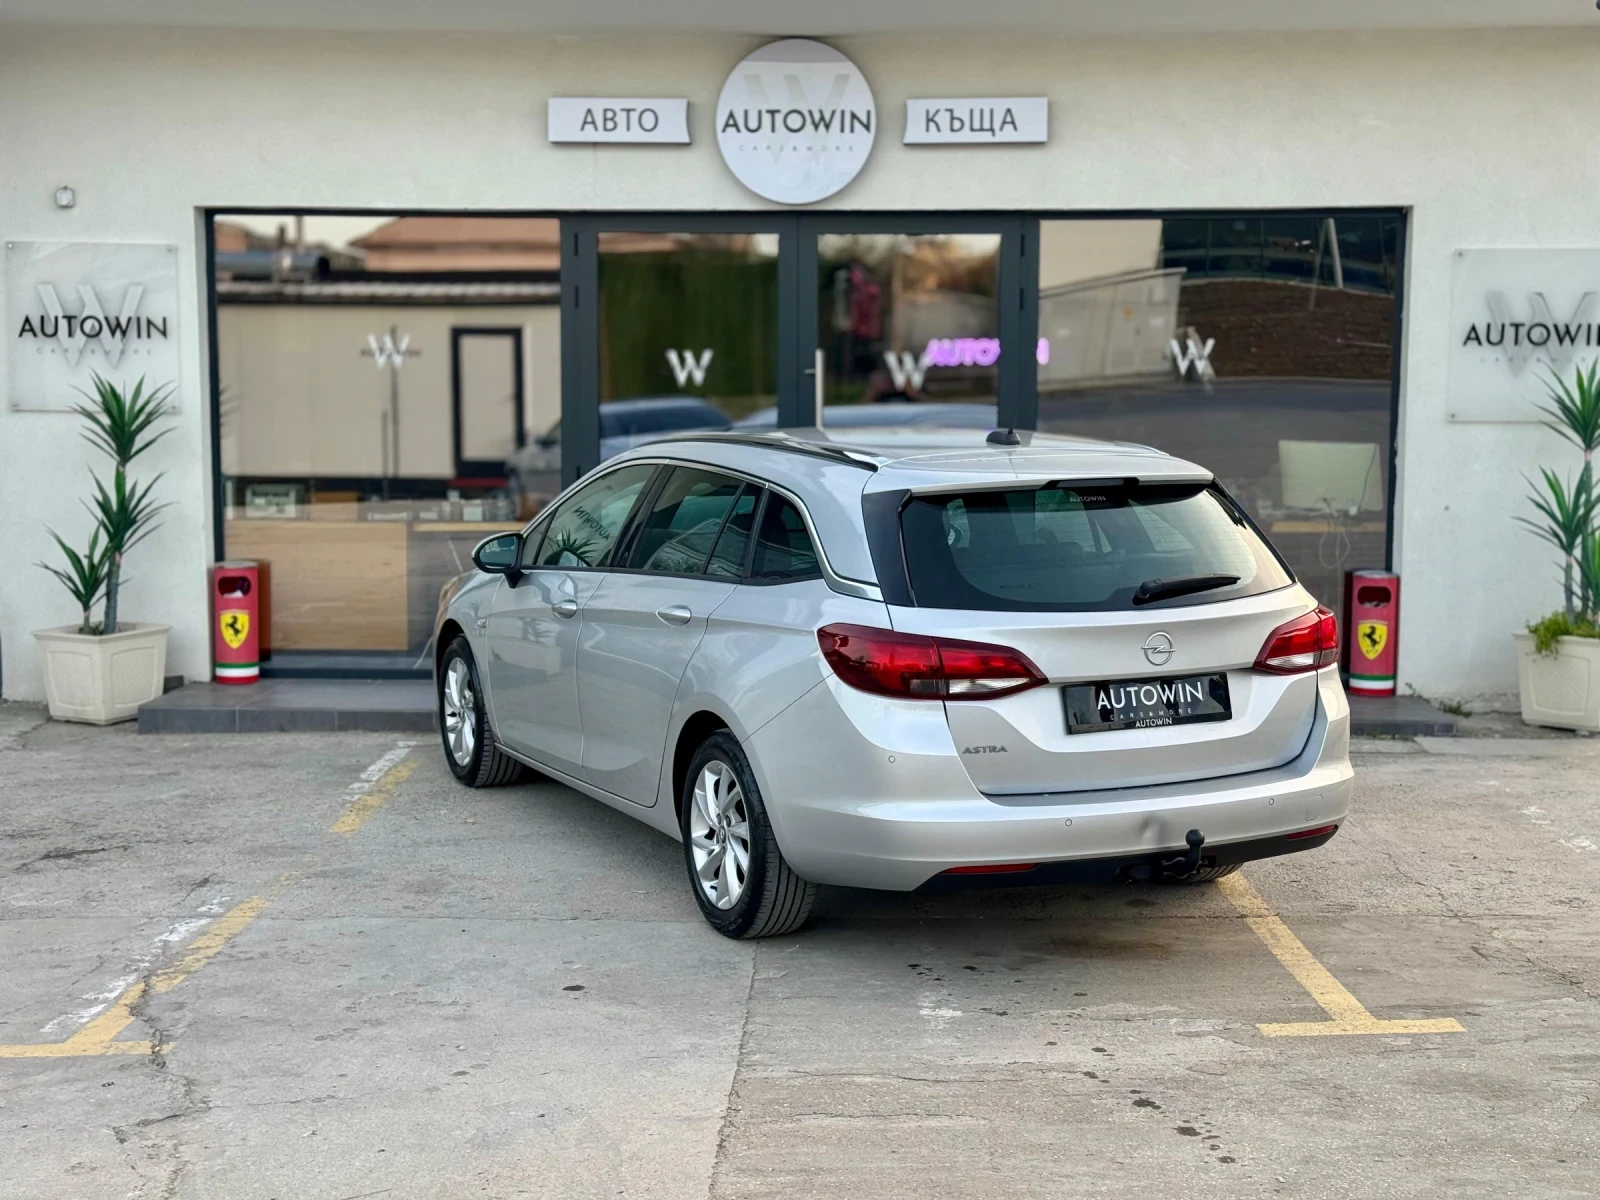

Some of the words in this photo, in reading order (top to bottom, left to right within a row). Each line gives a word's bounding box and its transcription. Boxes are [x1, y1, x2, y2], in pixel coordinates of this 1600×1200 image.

[580, 107, 660, 133] АВТО
[721, 108, 872, 134] AUTOWIN
[924, 107, 1019, 137] КЪЩА
[18, 314, 168, 339] AUTOWIN
[1462, 322, 1600, 347] AUTOWI
[366, 333, 411, 369] W
[1170, 337, 1216, 376] W
[665, 348, 714, 387] W
[883, 351, 929, 390] W
[1097, 681, 1204, 710] AUTOWIN
[1135, 717, 1173, 728] AUTOWIN
[961, 745, 1009, 755] ASTRA
